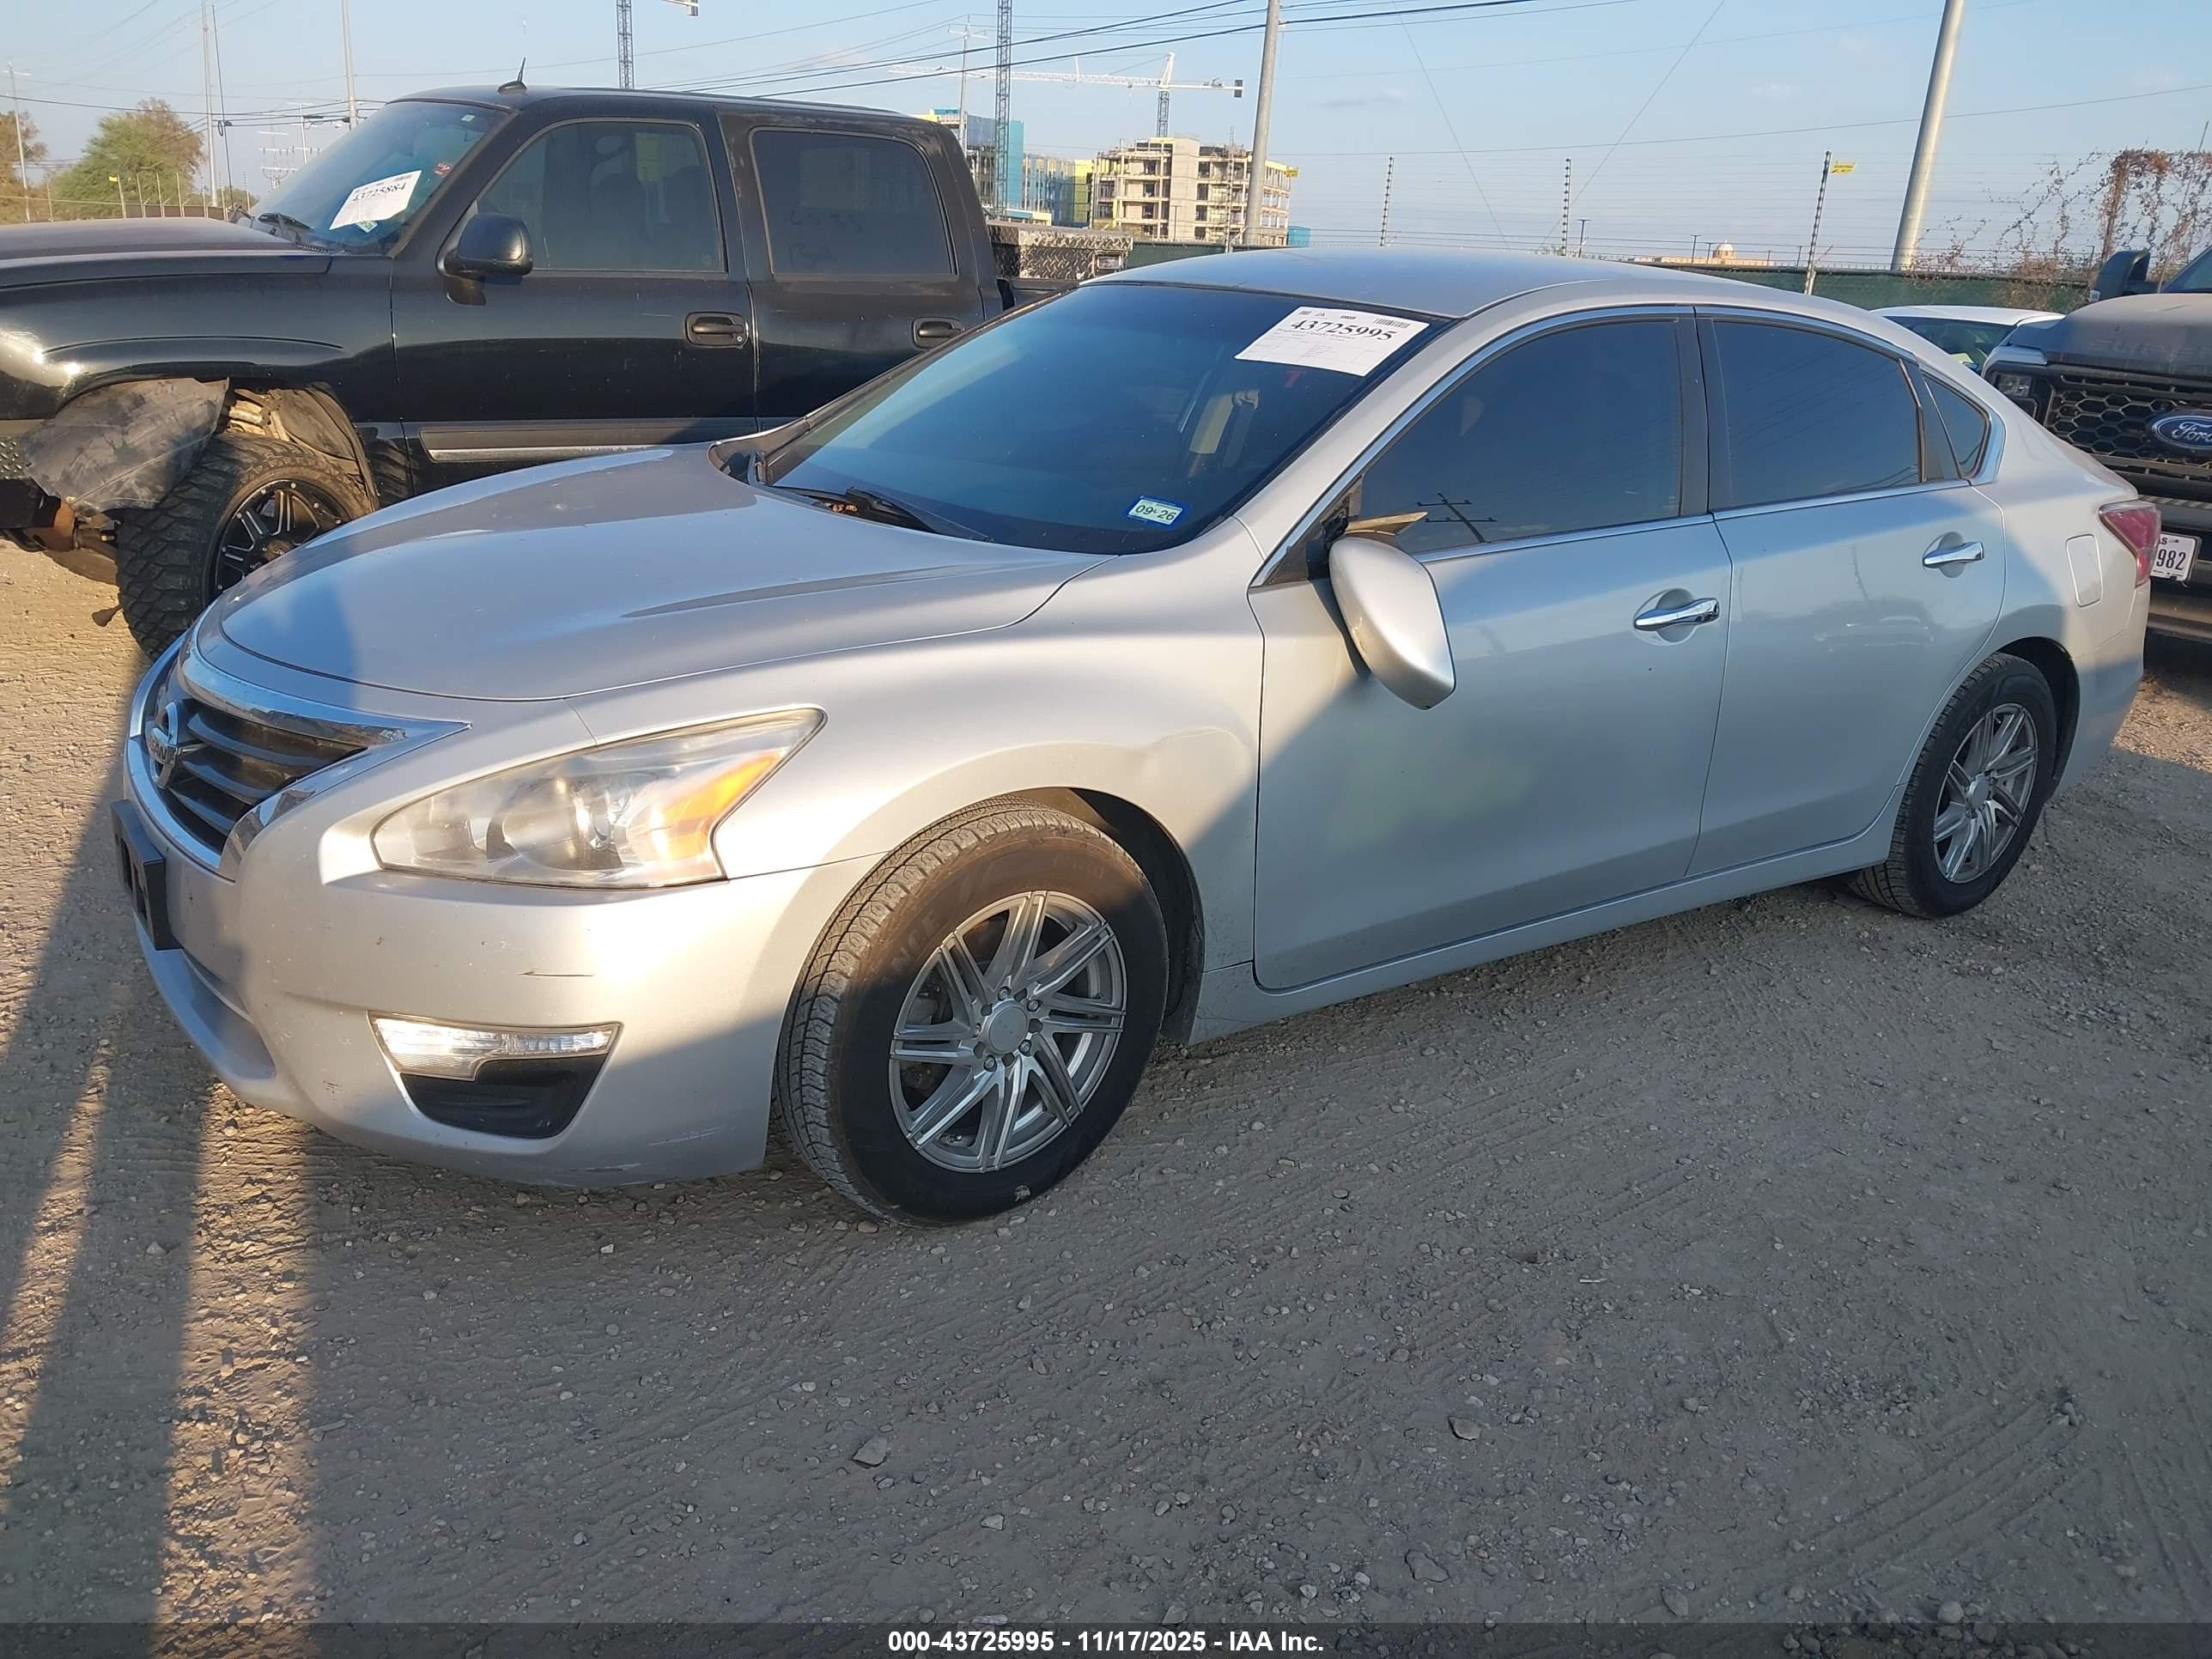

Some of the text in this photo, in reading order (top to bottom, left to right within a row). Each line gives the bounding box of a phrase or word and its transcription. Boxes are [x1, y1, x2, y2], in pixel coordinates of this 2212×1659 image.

[1291, 319, 1398, 342] 43725995
[1135, 504, 1177, 520] 09 26
